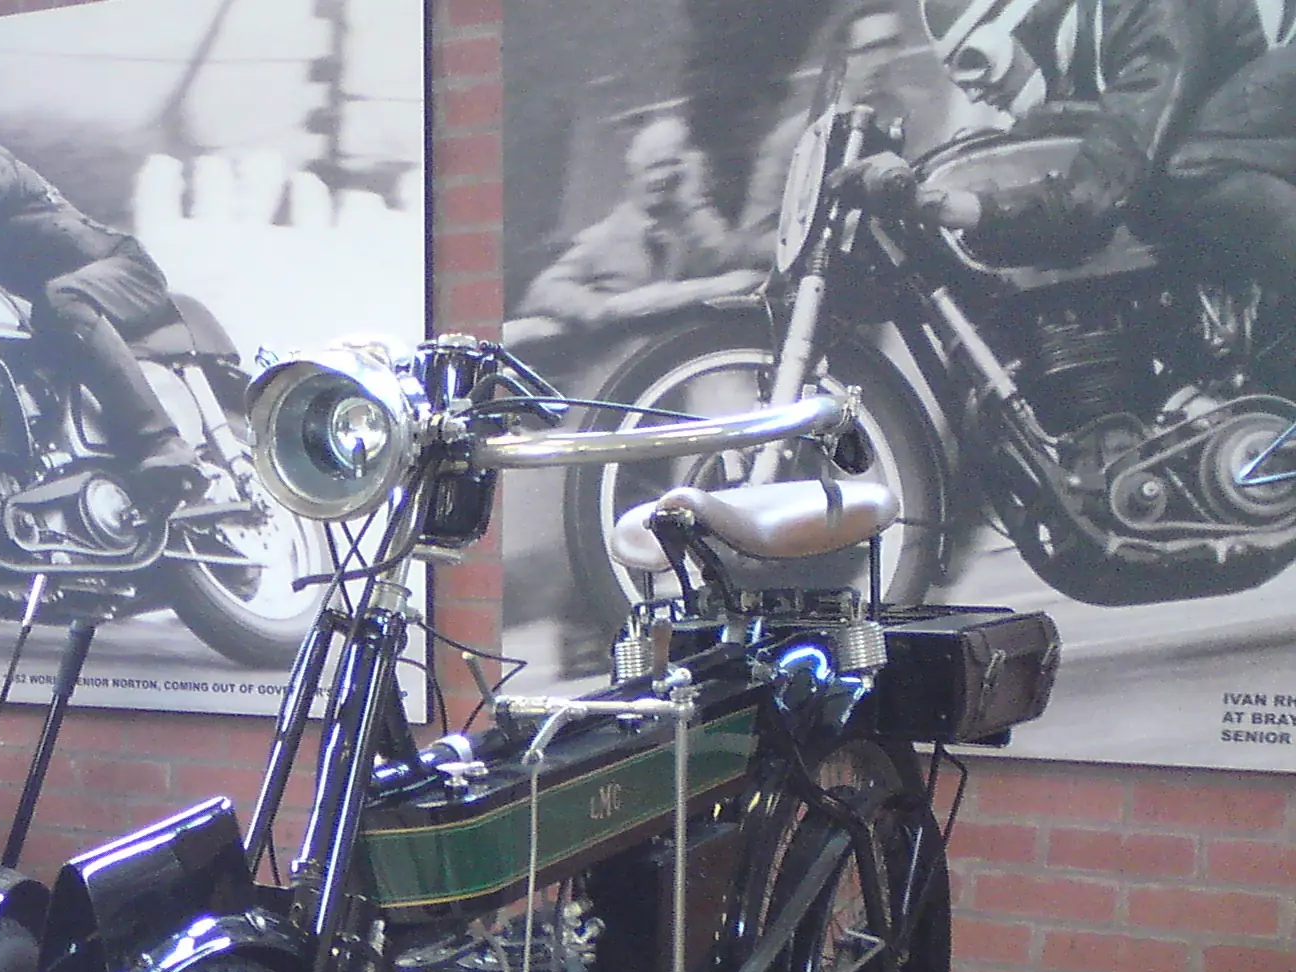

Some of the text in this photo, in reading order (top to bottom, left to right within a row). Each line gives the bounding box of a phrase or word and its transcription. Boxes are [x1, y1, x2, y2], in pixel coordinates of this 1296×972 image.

[75, 677, 109, 688] ENIOR
[164, 680, 209, 693] COMING
[212, 682, 236, 694] OUT
[240, 683, 254, 694] OF
[1223, 692, 1267, 706] IVAN
[1222, 711, 1244, 724] AT
[1220, 729, 1292, 744] SENIOR
